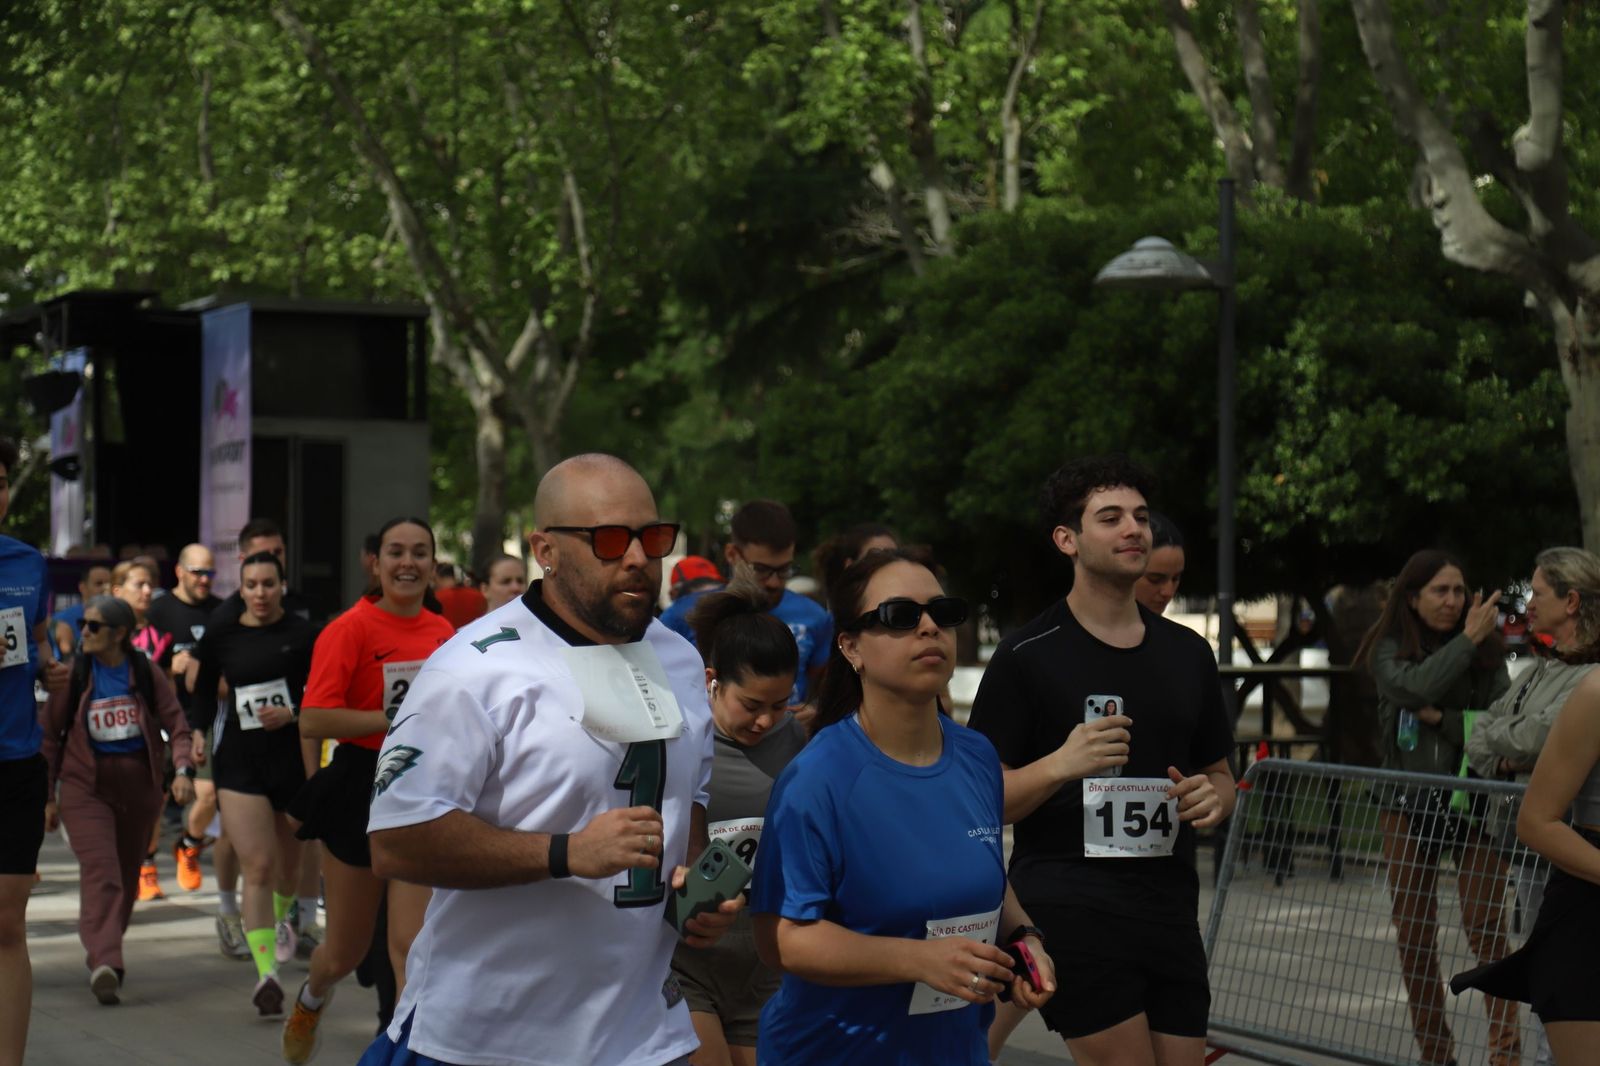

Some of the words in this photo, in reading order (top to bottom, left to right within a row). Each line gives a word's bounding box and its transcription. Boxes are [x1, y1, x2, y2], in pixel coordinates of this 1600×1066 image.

[470, 626, 521, 654] 1
[1116, 784, 1150, 792] CASTILLA
[1149, 784, 1156, 792] Y
[1157, 783, 1171, 792] LEÓ
[1096, 801, 1172, 838] 154
[945, 926, 956, 935] DE
[957, 920, 988, 933] CASTILLA
